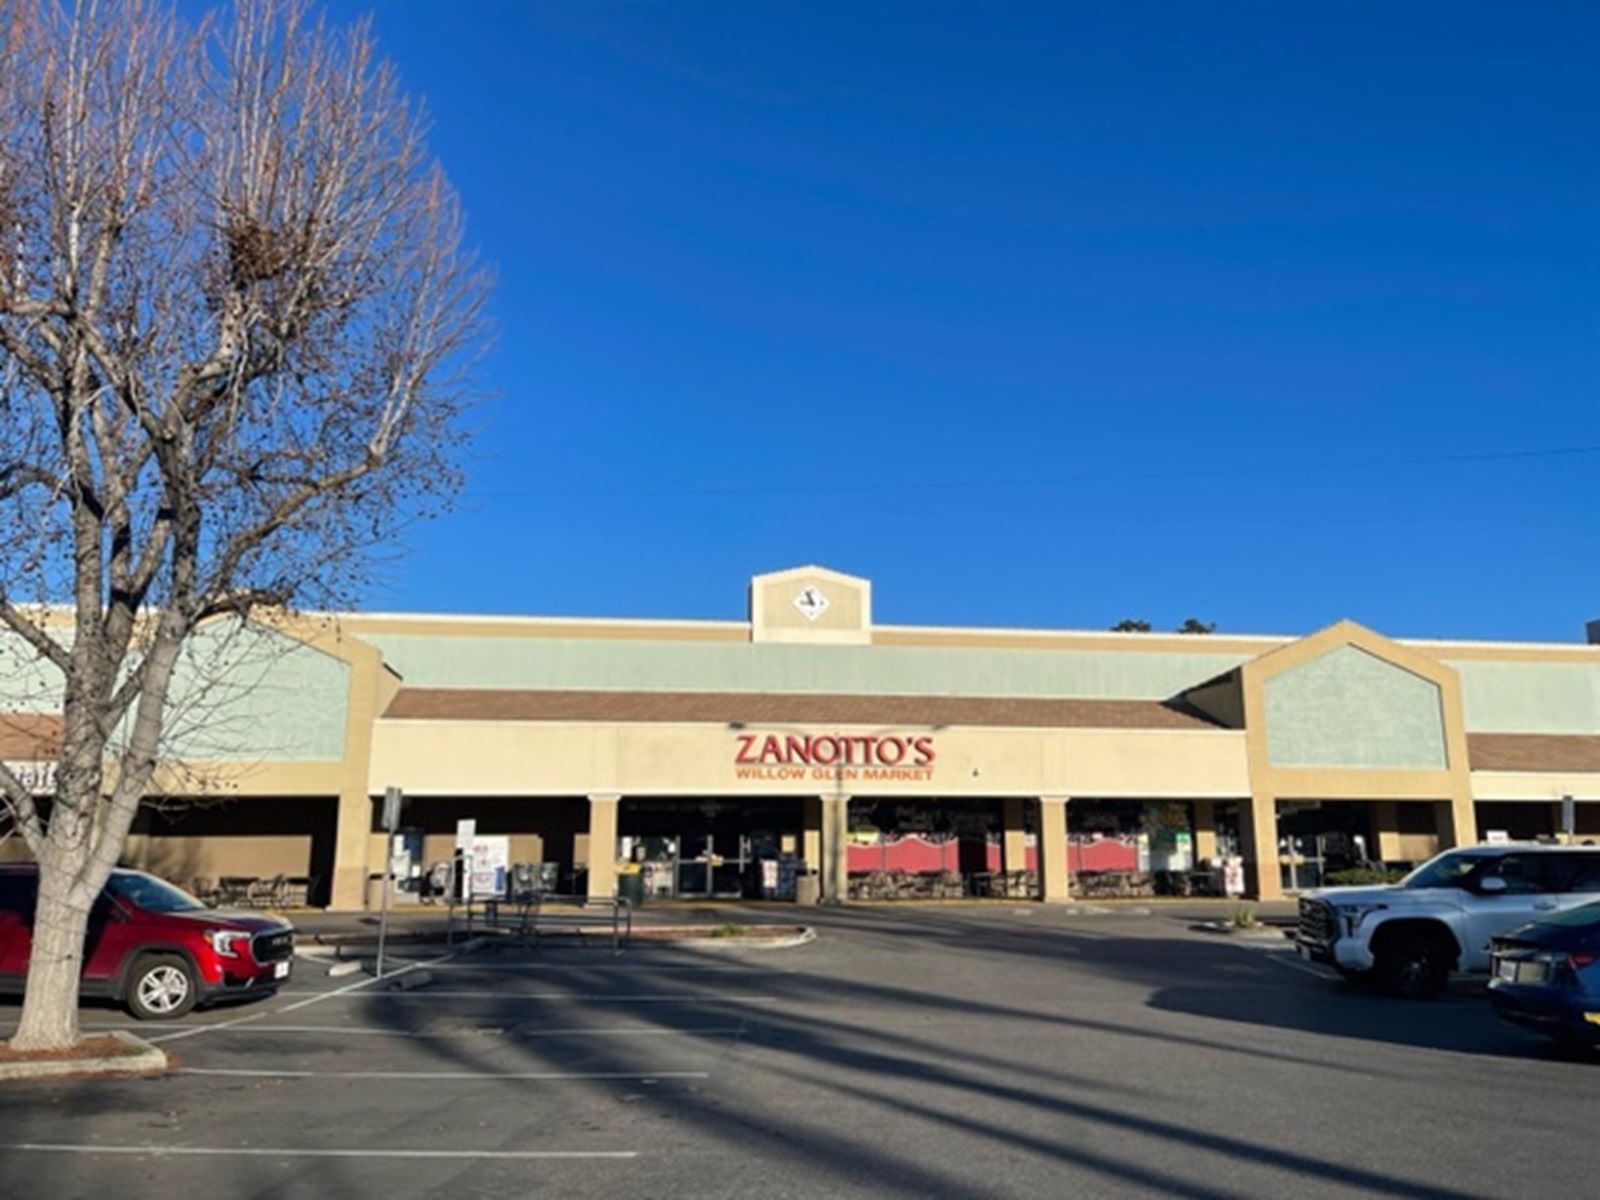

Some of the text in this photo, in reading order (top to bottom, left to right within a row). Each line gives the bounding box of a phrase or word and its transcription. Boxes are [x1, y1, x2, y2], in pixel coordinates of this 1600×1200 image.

[735, 734, 936, 765] ZANOTTO'S
[736, 767, 934, 781] WILLOW GLEN MARKET
